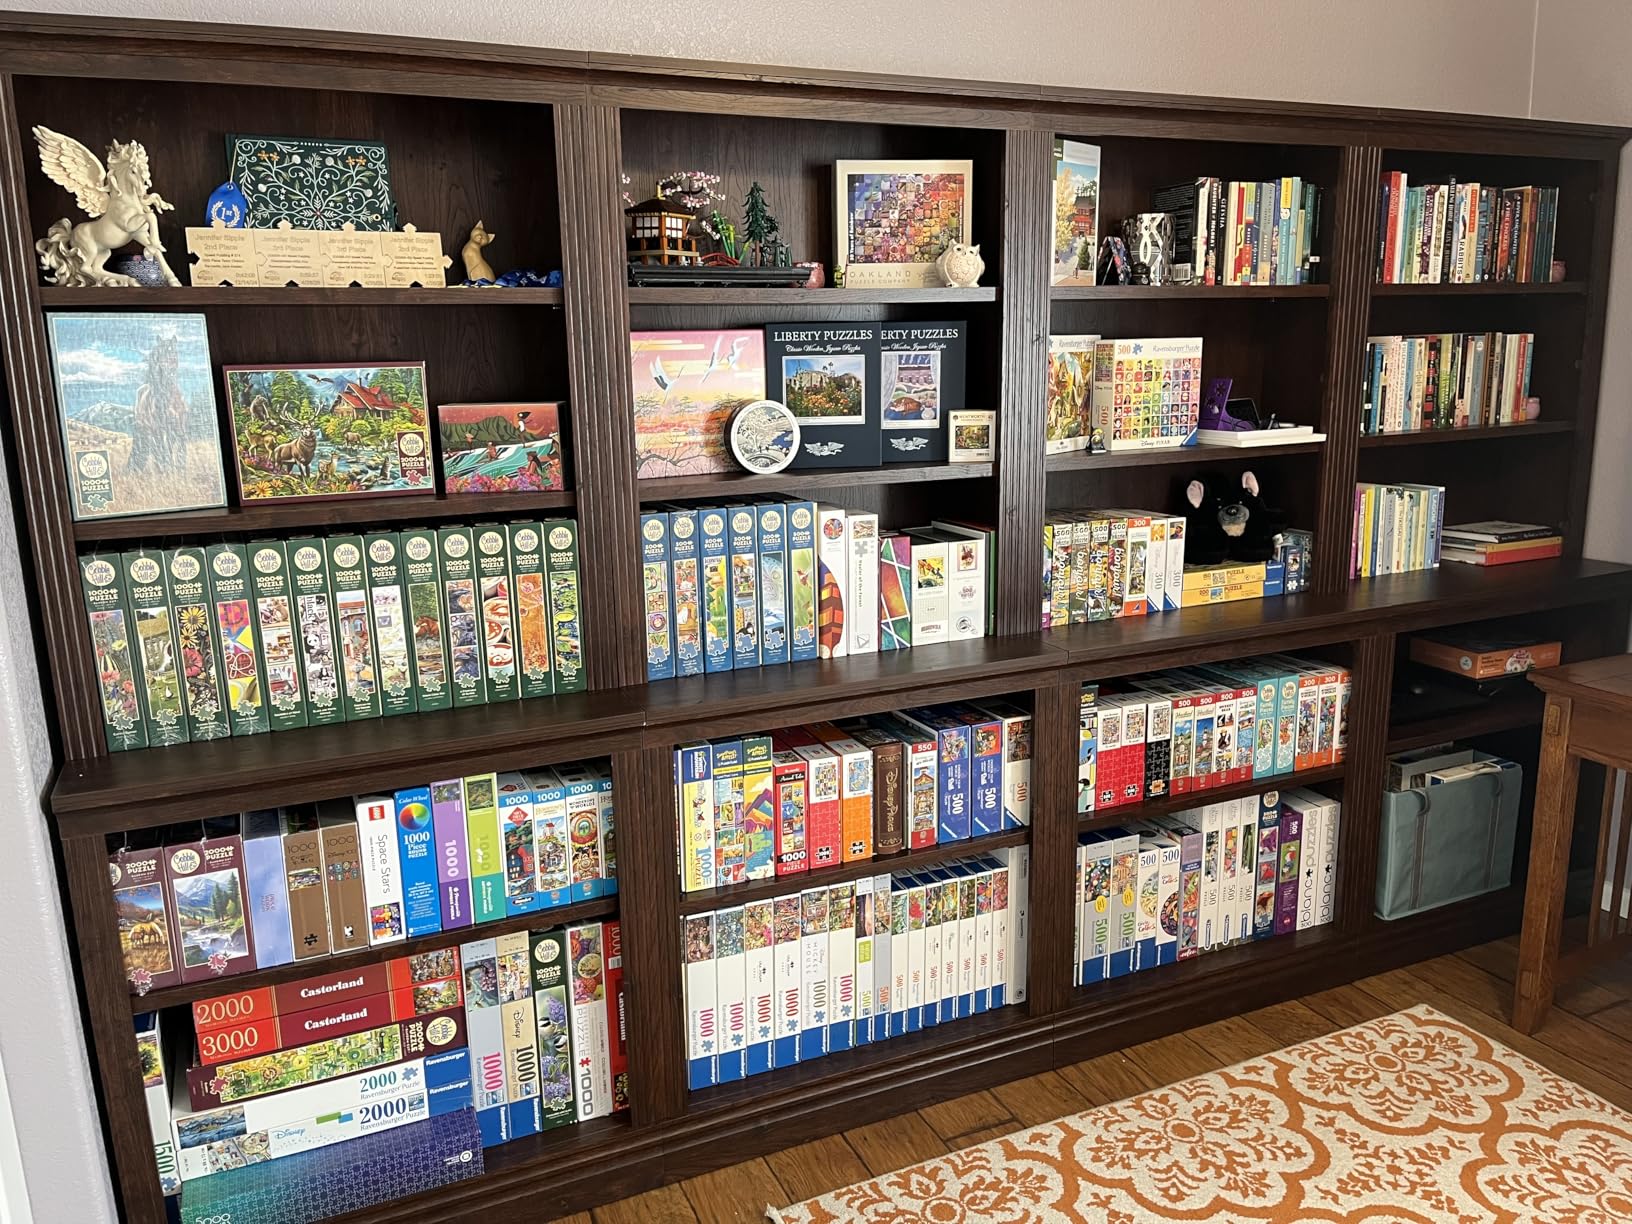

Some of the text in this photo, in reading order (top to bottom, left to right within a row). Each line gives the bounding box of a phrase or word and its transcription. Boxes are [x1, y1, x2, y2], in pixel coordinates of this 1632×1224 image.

[1502, 224, 1510, 250] ENDLESS
[1457, 241, 1465, 275] RABBITS
[774, 330, 873, 341] LIBERTY PUZZLES
[881, 329, 958, 340] ERTY PUZZLES
[785, 344, 861, 354] Classic Wooden Jigsaw Puzzles
[909, 343, 928, 351] Jigsaw
[928, 342, 947, 350] Puzzles
[1118, 345, 1131, 354] 500
[447, 564, 470, 572] PUZZLE
[257, 580, 284, 588] PUZZLE
[297, 578, 323, 586] PUZZLE
[336, 574, 362, 582] PUZZLE
[216, 584, 244, 592] PUZZLE
[89, 594, 118, 602] PUZZLE
[1200, 697, 1212, 705] 500
[918, 743, 932, 751] 550
[570, 784, 594, 794] 1000
[603, 782, 612, 791] 10
[1016, 782, 1027, 802] 500
[505, 795, 529, 805] 1000
[537, 791, 560, 801] 1000
[984, 787, 996, 809] 500
[952, 793, 963, 814] 500
[327, 836, 354, 846] 1000
[403, 832, 430, 844] 1000
[288, 842, 316, 854] 1000
[407, 843, 426, 851] Piece
[206, 850, 234, 860] PUZZLE
[444, 840, 459, 877] 1000
[696, 846, 712, 878] 1000
[781, 851, 806, 862] 1000
[1140, 853, 1157, 866] 500
[1162, 849, 1180, 863] 500
[128, 864, 156, 873] PUZZLE
[377, 834, 391, 894] Space Stars
[782, 864, 805, 872] PUZZLE
[1301, 810, 1318, 923] blanc puzzles
[1321, 806, 1336, 921] blanc puzzles
[1209, 889, 1217, 905] 500
[1095, 918, 1108, 943] 500
[1122, 911, 1134, 936] 500
[963, 957, 971, 971] 500
[980, 953, 988, 967] 500
[536, 970, 562, 980] PUZZLE
[930, 966, 938, 979] 500
[946, 961, 954, 975] 500
[896, 975, 904, 989] 500
[912, 970, 920, 984] 500
[813, 979, 826, 1008] 1000
[839, 974, 853, 1002] 1000
[197, 976, 364, 1026] 2000 Castorland
[785, 988, 799, 1017] 1000
[862, 990, 871, 1007] 500
[880, 986, 889, 1006] 500
[757, 993, 771, 1023] 1000
[512, 1007, 525, 1038] Disney
[700, 1008, 714, 1037] 1000
[729, 1002, 744, 1031] 1000
[202, 1008, 368, 1057] 3000 Castorland
[425, 1052, 466, 1066] Ravensburger
[516, 1044, 535, 1084] 1000
[576, 1008, 593, 1116] PUZZLE 1000
[483, 1052, 503, 1091] 1000
[359, 1070, 398, 1094] 2000
[429, 1080, 469, 1095] Ravensburger
[360, 1079, 421, 1100] Ravensburger Puzzle
[359, 1097, 407, 1125] 2000
[360, 1107, 426, 1132] Ravensburger Puzzle
[274, 1126, 306, 1139] Disney
[154, 1139, 175, 1175] 1500
